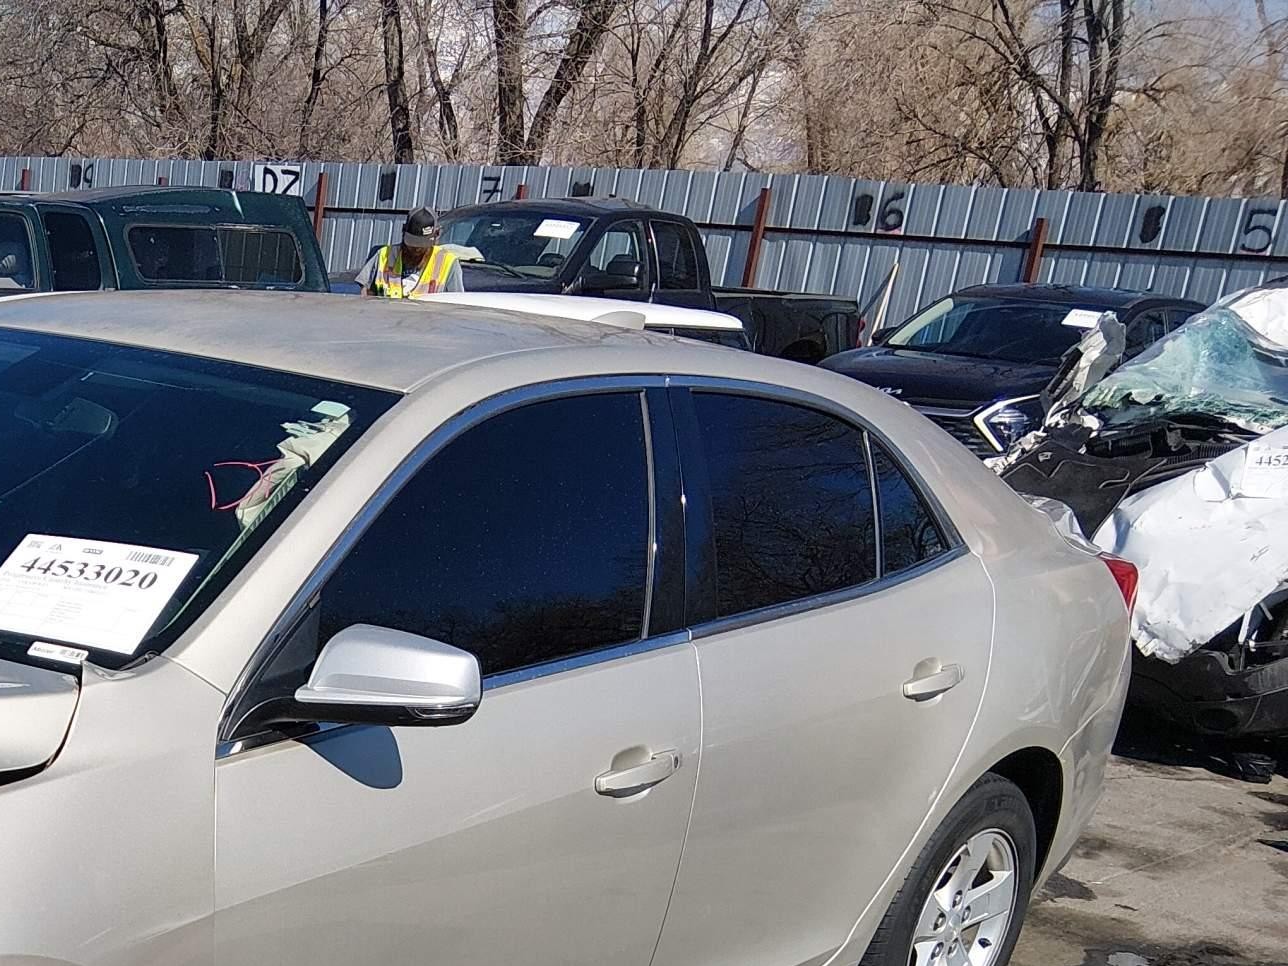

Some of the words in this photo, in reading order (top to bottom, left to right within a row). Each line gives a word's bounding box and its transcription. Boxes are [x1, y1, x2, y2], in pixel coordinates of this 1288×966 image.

[482, 176, 501, 203] 7
[880, 192, 904, 231] 6
[1240, 209, 1278, 254] 5
[20, 556, 158, 590] 44533020
